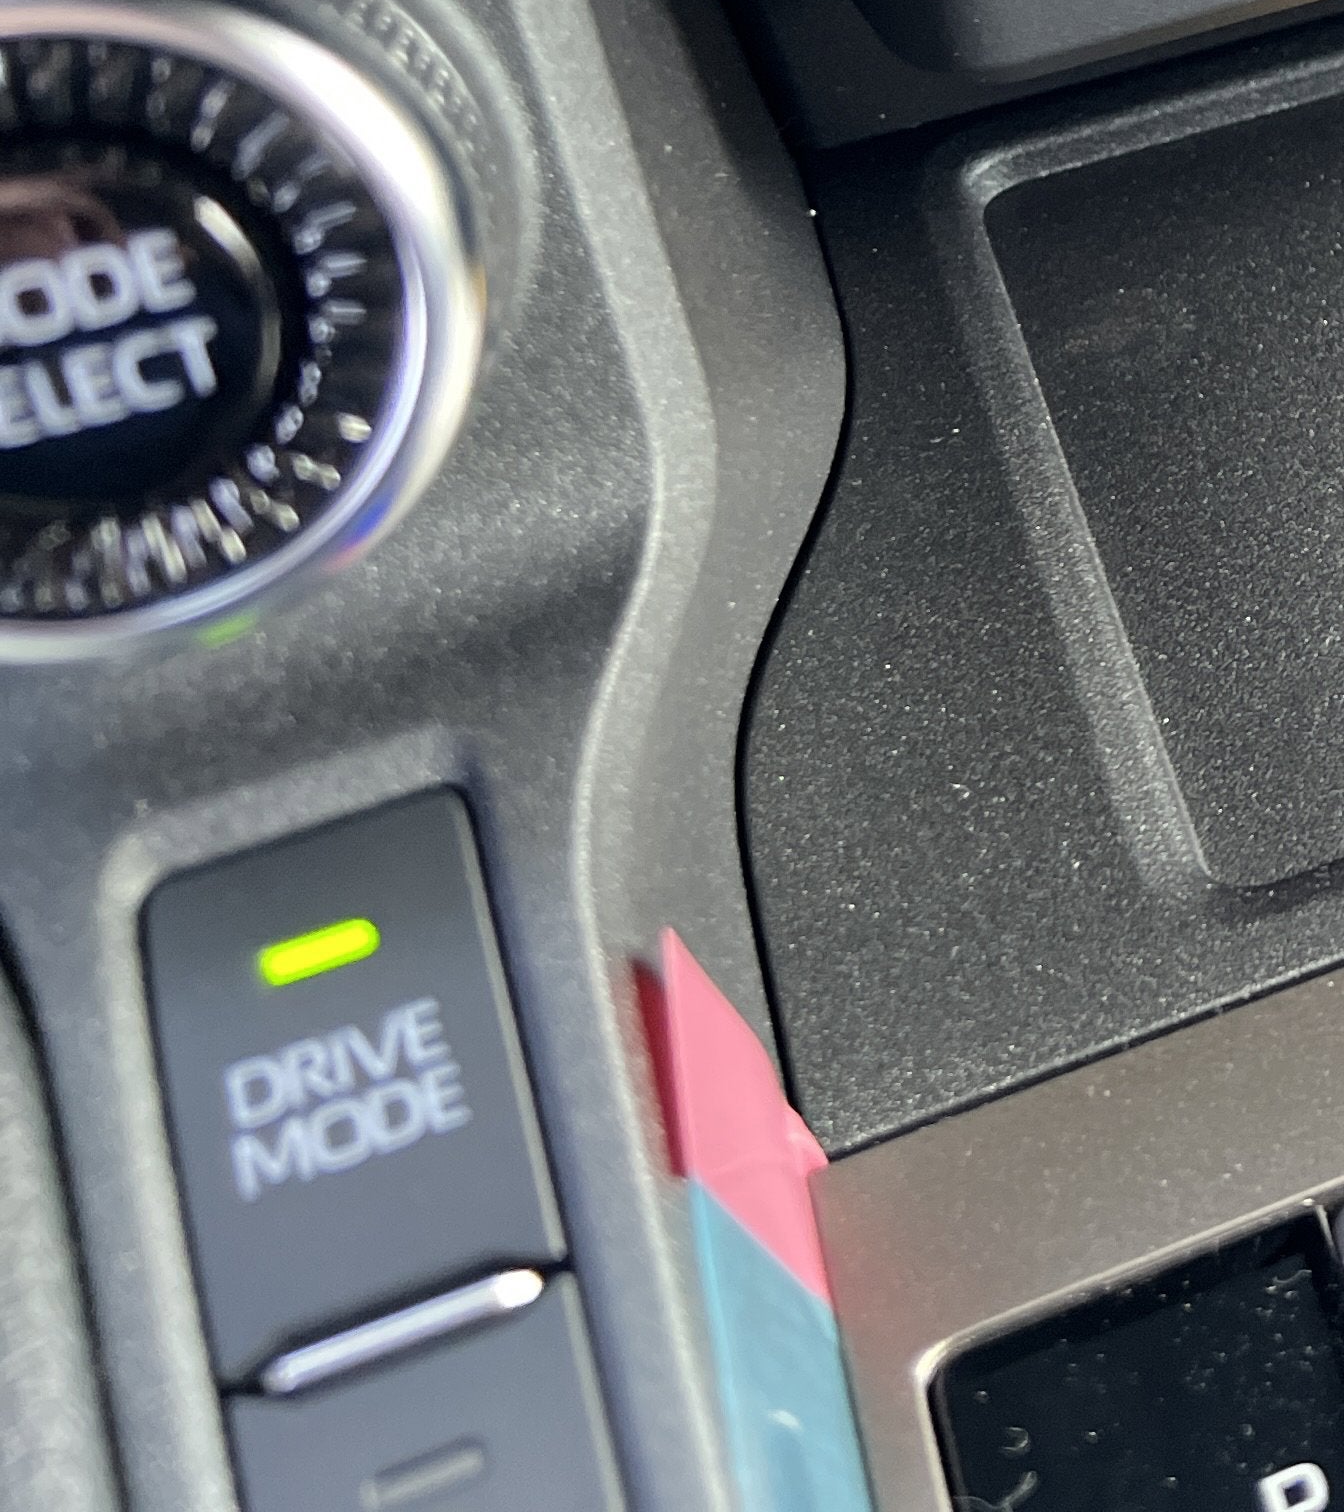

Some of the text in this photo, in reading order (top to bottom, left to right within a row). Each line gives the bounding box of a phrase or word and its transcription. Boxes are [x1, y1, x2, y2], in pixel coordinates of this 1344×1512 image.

[0, 226, 198, 348] ODE
[0, 314, 220, 449] ELECT
[223, 996, 451, 1130] DRIVE
[229, 1062, 473, 1202] MODE
